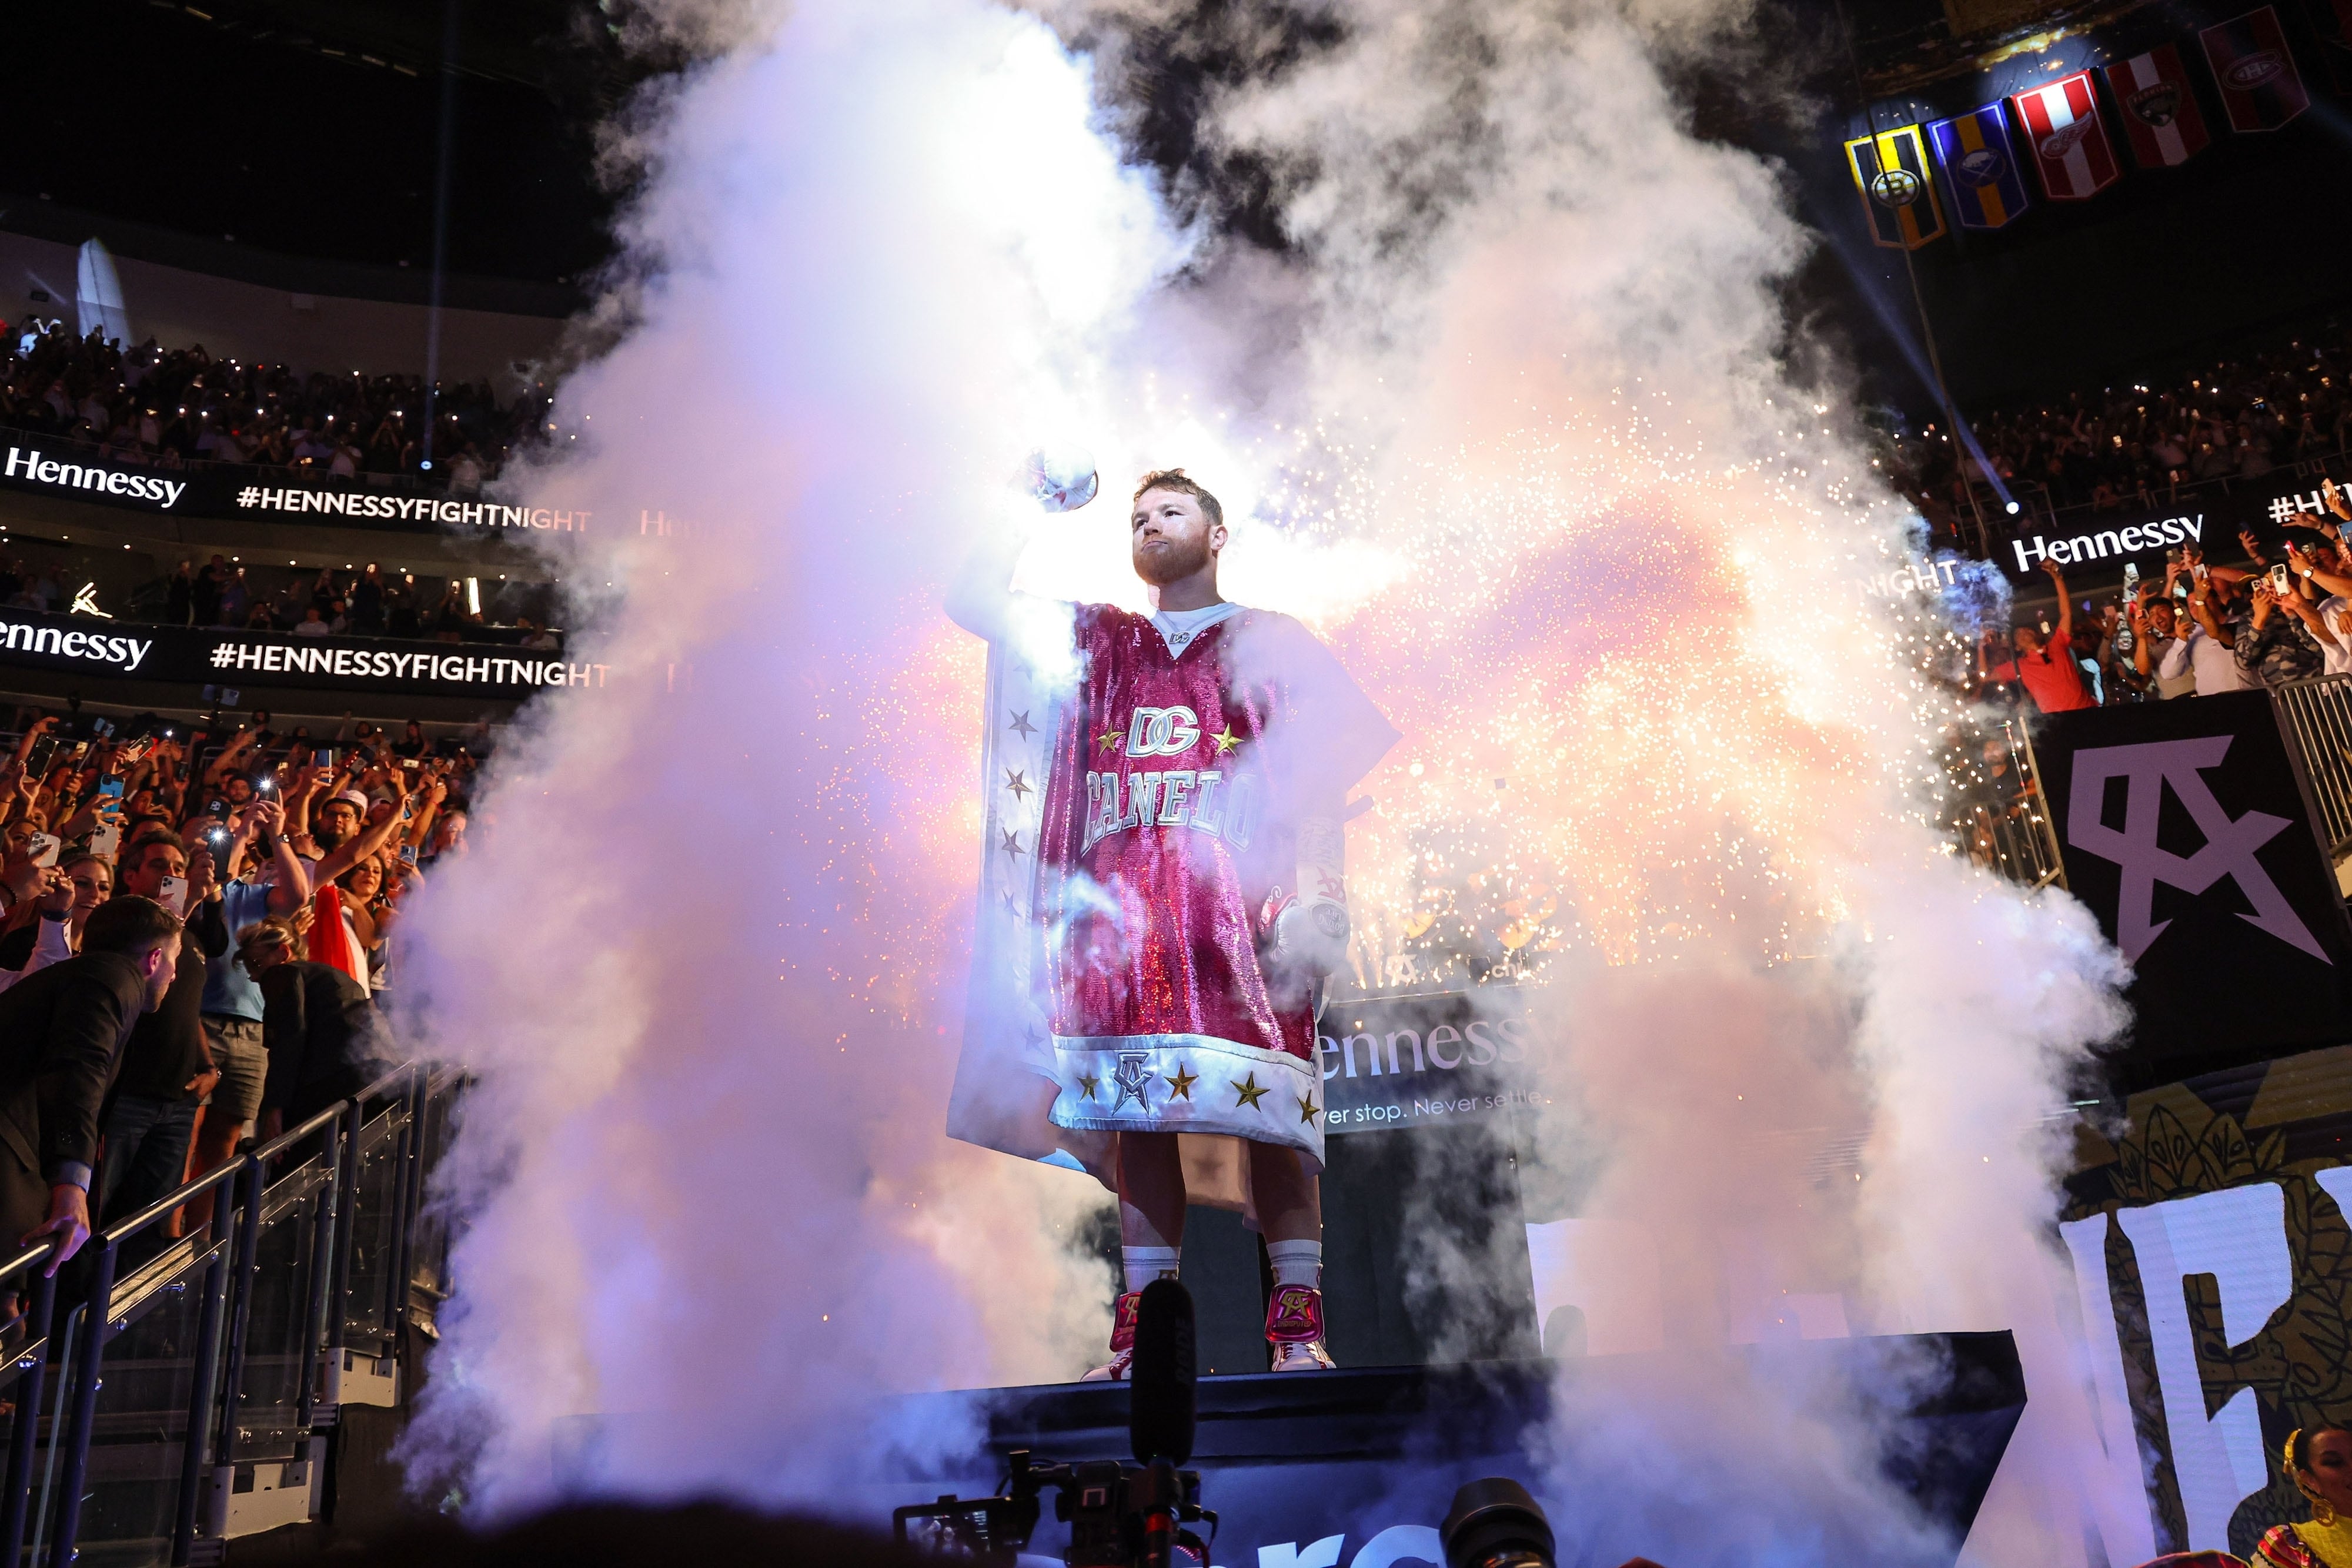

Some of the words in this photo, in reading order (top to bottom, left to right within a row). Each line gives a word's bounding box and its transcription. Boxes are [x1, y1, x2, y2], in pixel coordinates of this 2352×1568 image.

[5, 447, 186, 508] Hennessy
[237, 486, 592, 531] #HENNESSYFIGHTNIGHT
[2012, 514, 2203, 573] Hennessy
[210, 643, 610, 687] #HENNESSYFIGHTNIGHT
[1125, 706, 1201, 758] DG
[1355, 1103, 1407, 1124] stop.
[1414, 1098, 1478, 1117] Never
